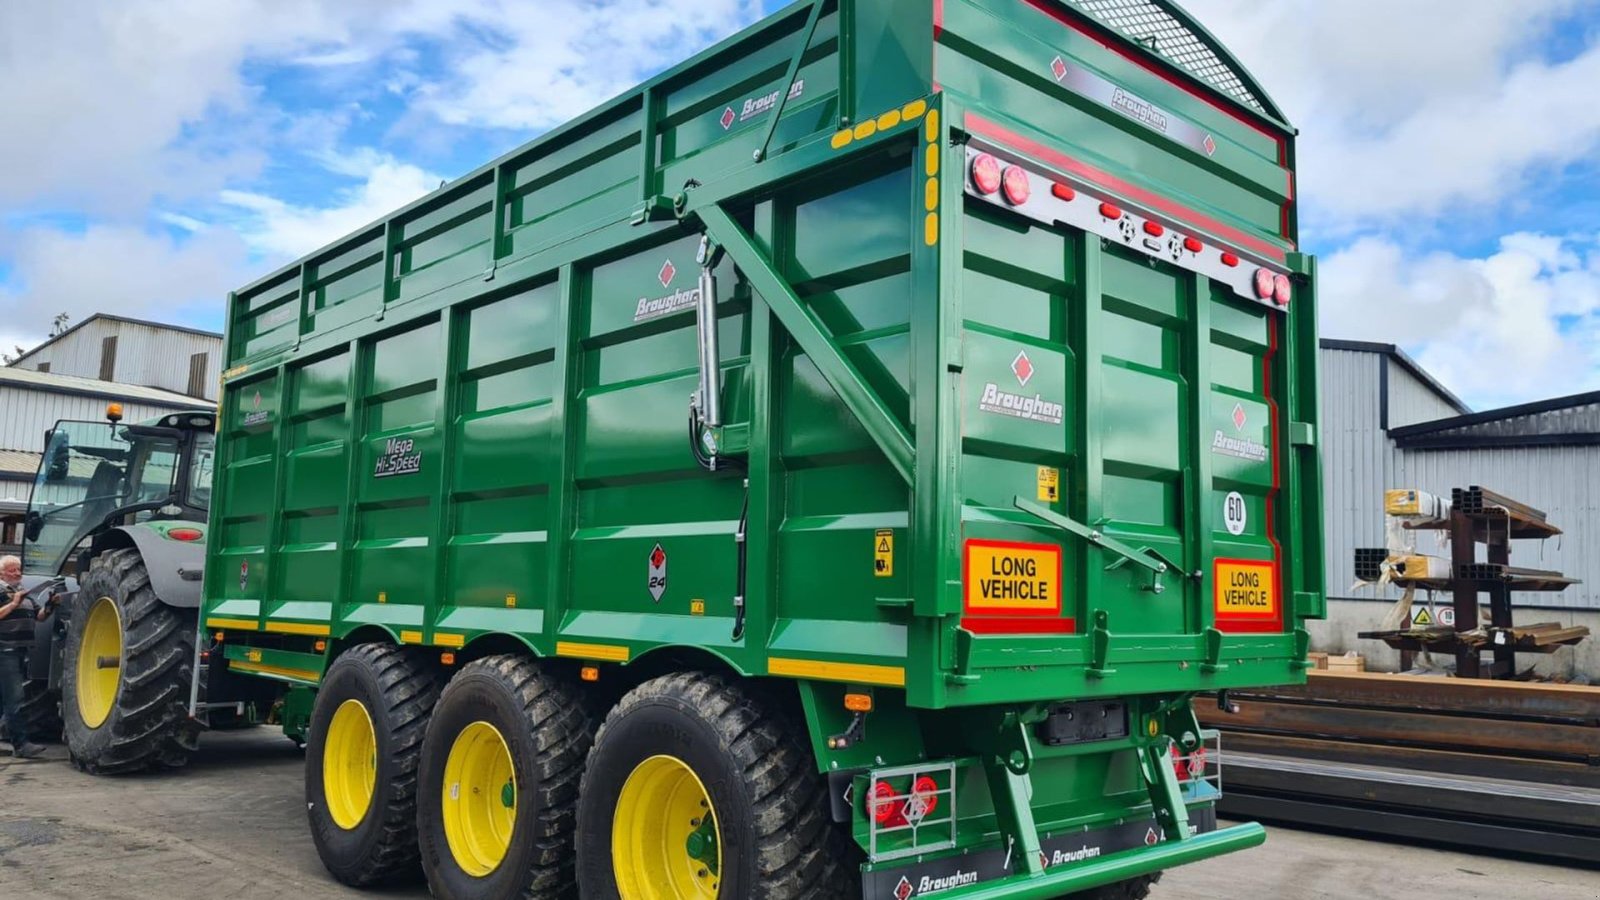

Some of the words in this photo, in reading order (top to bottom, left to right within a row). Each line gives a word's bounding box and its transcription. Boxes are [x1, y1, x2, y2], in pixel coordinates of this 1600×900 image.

[980, 383, 1063, 420] Broughan
[385, 438, 413, 457] Mega
[1212, 430, 1266, 458] Broughan
[1228, 496, 1241, 522] 60
[992, 556, 1036, 577] LONG
[649, 576, 665, 588] 24
[980, 579, 1048, 600] VEHICLE
[1231, 571, 1259, 588] LONG
[1224, 590, 1267, 606] VEHICLE
[1052, 845, 1100, 865] Broughan
[917, 870, 977, 893] Broughan
